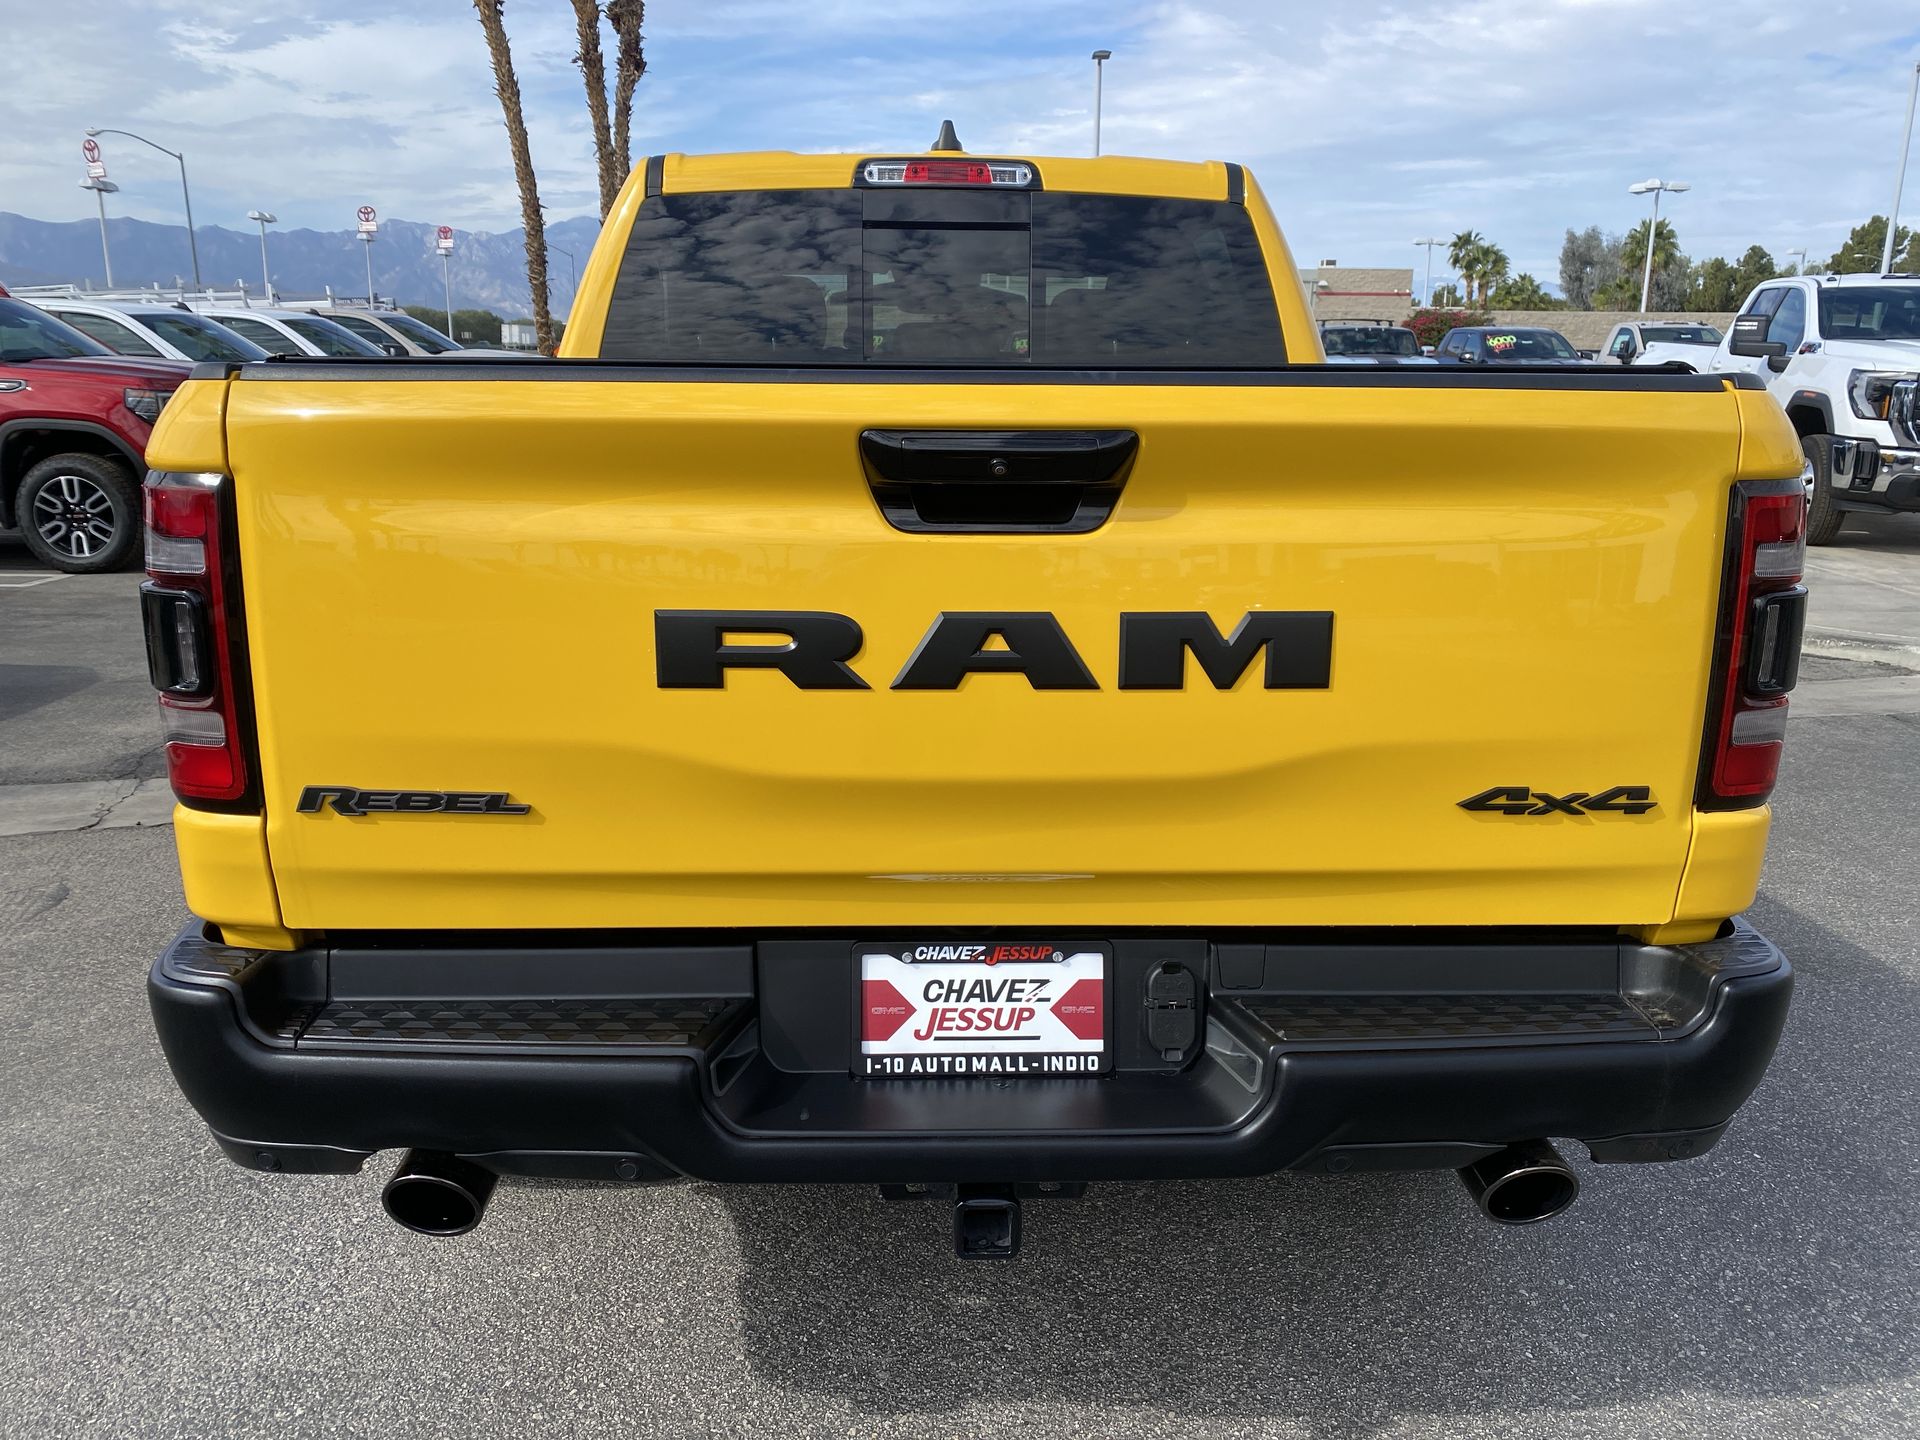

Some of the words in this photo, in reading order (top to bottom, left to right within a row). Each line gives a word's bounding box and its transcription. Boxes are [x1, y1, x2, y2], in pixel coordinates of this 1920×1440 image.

[654, 610, 1334, 690] RAM
[296, 785, 531, 816] REBEL
[915, 946, 986, 960] CHAVEZ
[985, 946, 1053, 966] JESSUP
[923, 979, 1051, 1002] CHAVEZ
[871, 1006, 906, 1015] GMC
[1061, 1006, 1096, 1014] GMC
[914, 1007, 1036, 1040] JESSUP
[866, 1057, 904, 1073] I-10
[910, 1057, 966, 1072] AUTO
